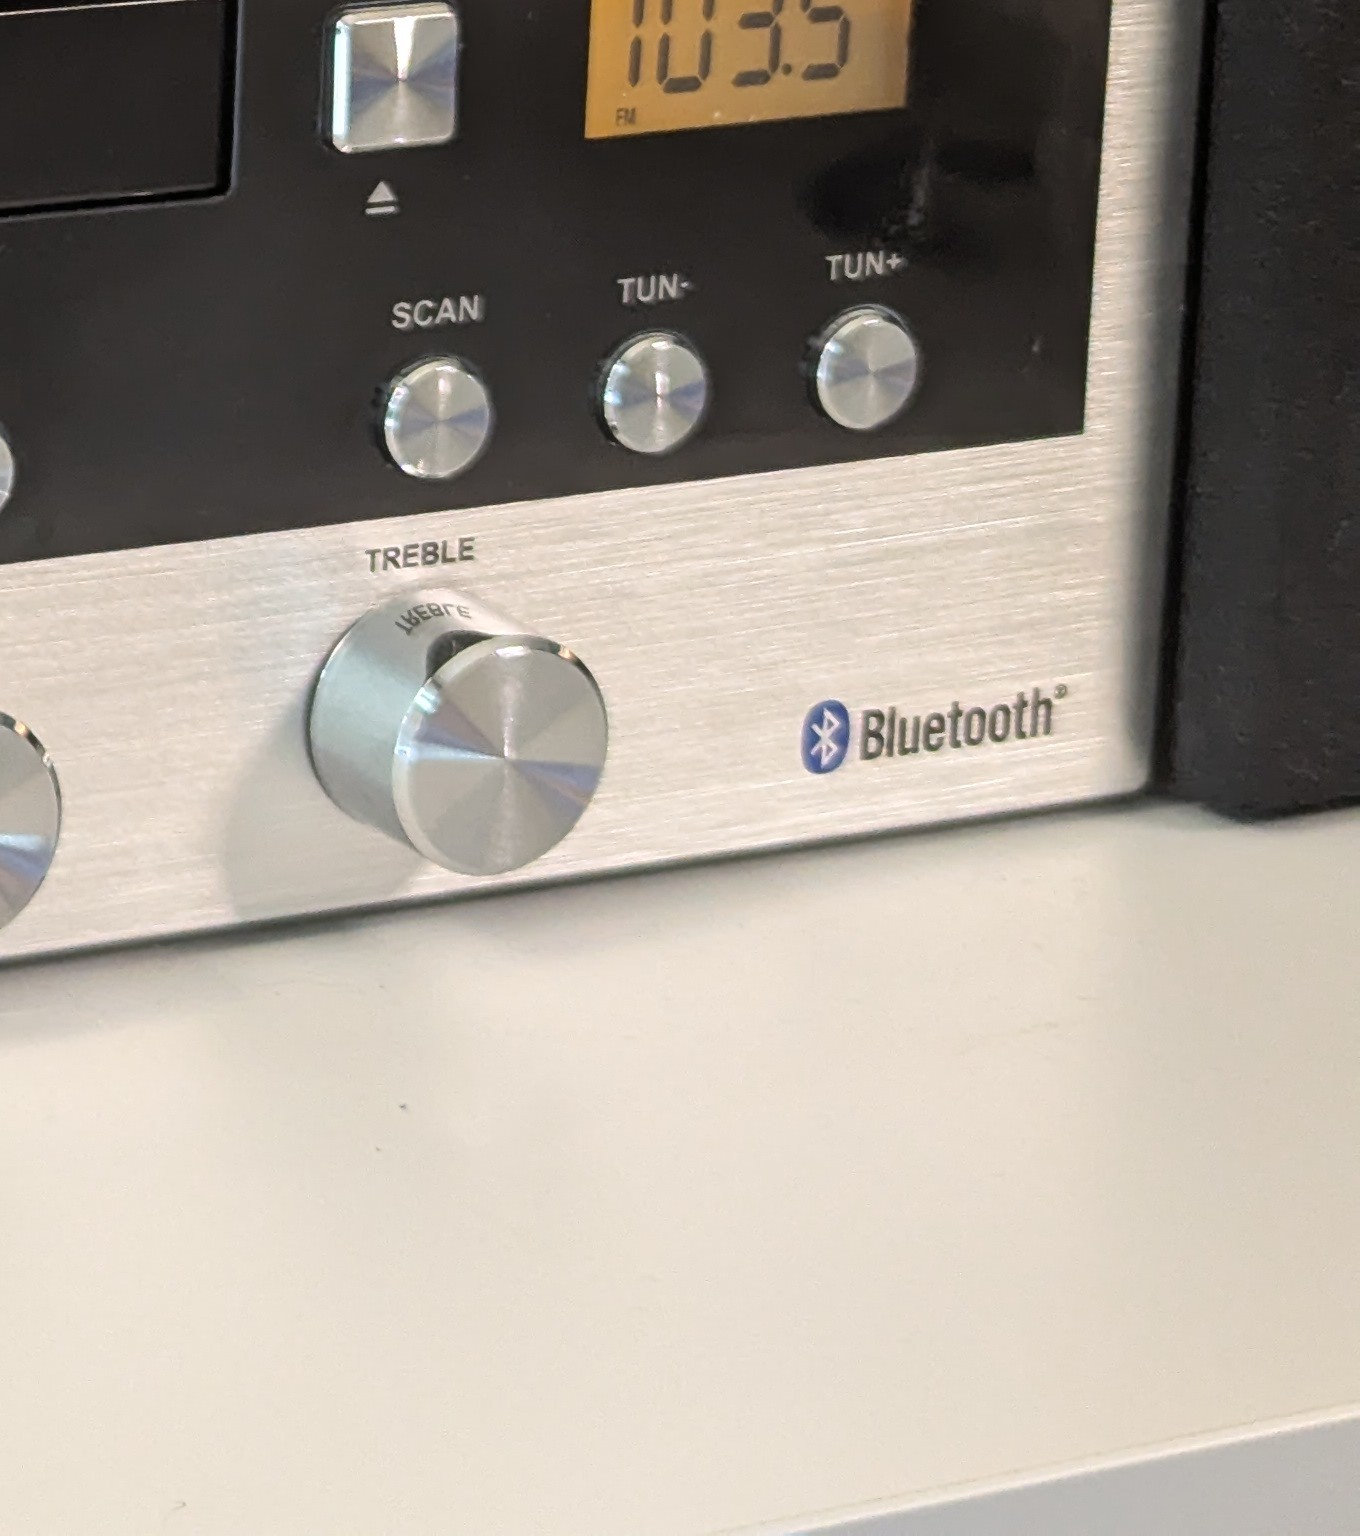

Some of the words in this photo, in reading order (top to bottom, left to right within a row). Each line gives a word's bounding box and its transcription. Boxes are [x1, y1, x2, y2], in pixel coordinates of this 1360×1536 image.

[615, 107, 637, 126] FM
[825, 251, 904, 280] TUN+
[392, 294, 482, 329] SCAN
[365, 536, 476, 573] TREBLE
